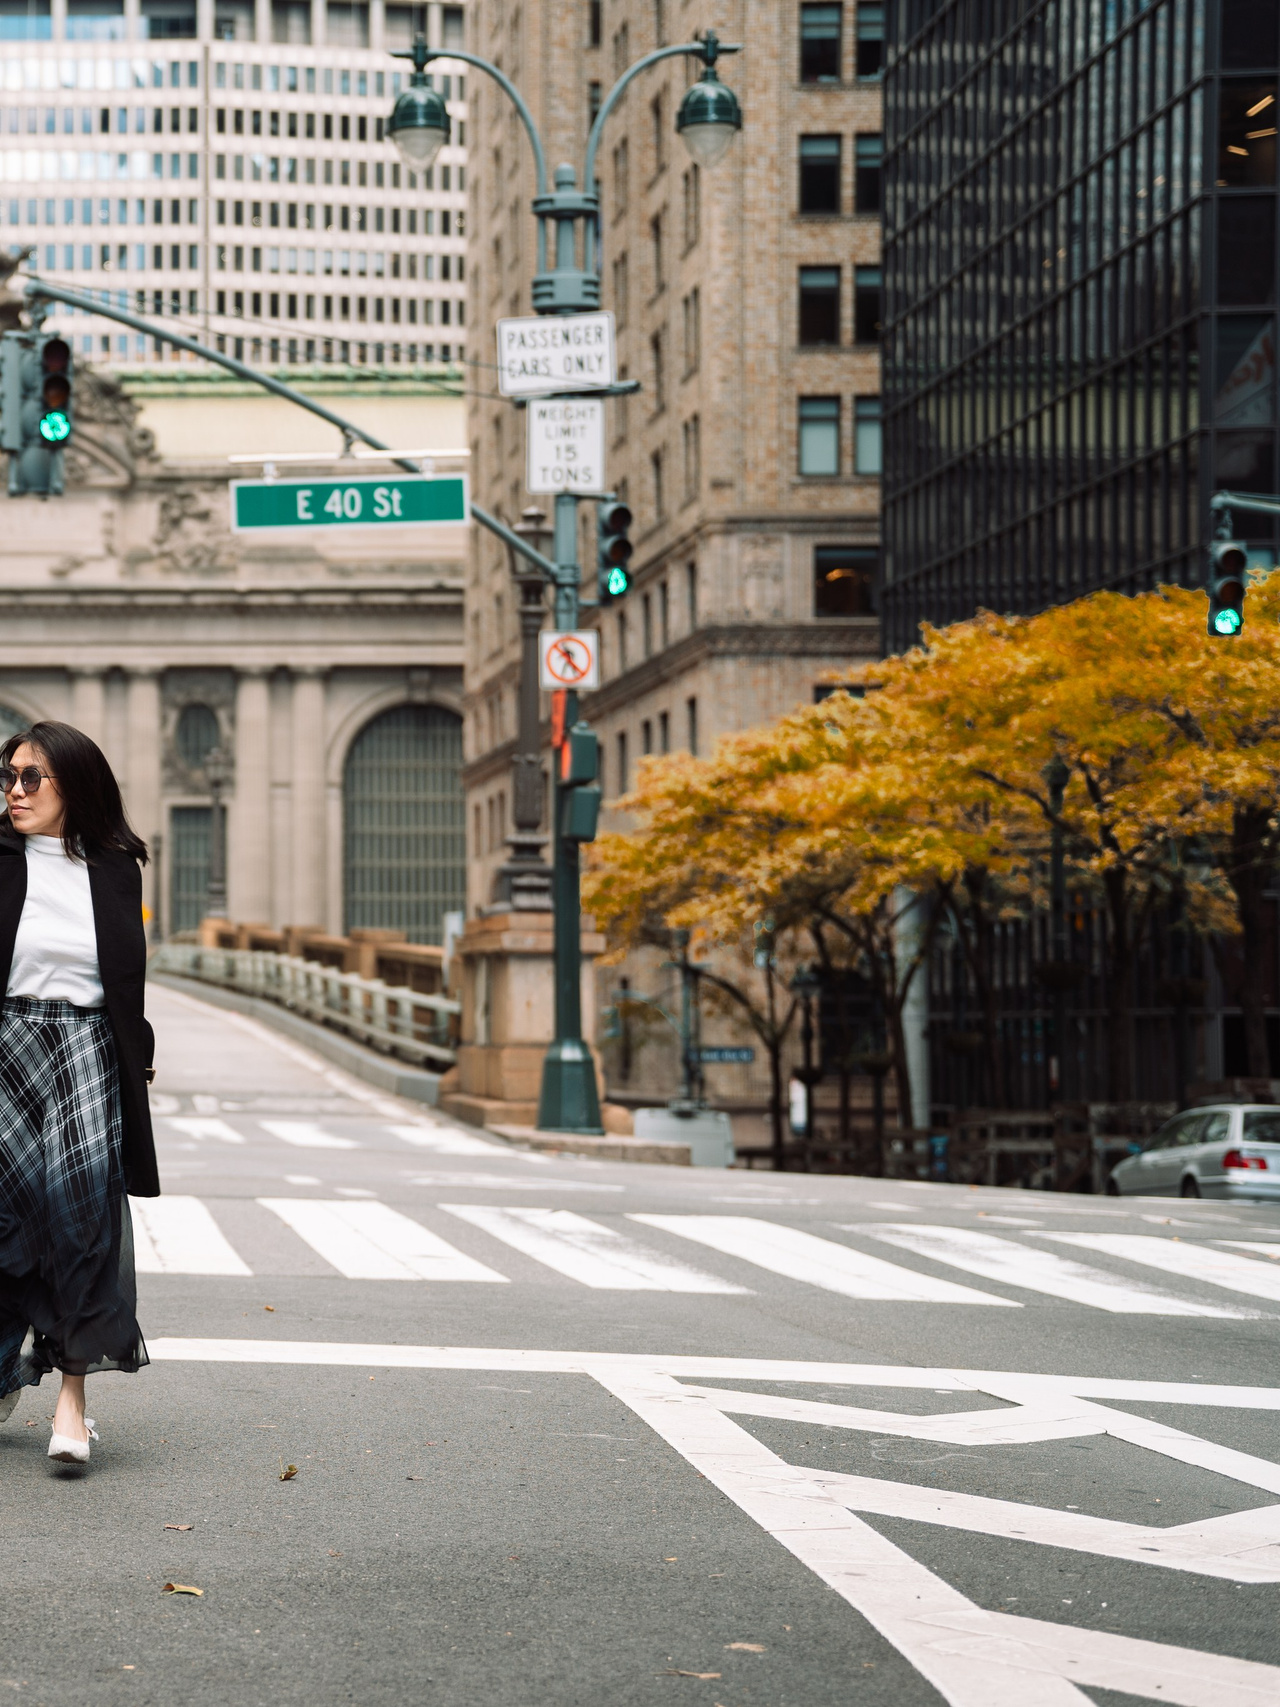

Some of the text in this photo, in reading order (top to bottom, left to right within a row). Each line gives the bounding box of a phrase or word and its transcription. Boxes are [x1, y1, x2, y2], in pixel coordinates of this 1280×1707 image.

[507, 325, 604, 350] PASSENGER
[508, 352, 605, 378] CARS ONLY
[537, 406, 597, 421] WEIGHT
[544, 425, 587, 439] LIMIT
[554, 444, 577, 461] 15
[540, 466, 593, 483] TONS
[296, 487, 403, 520] E 40 St
